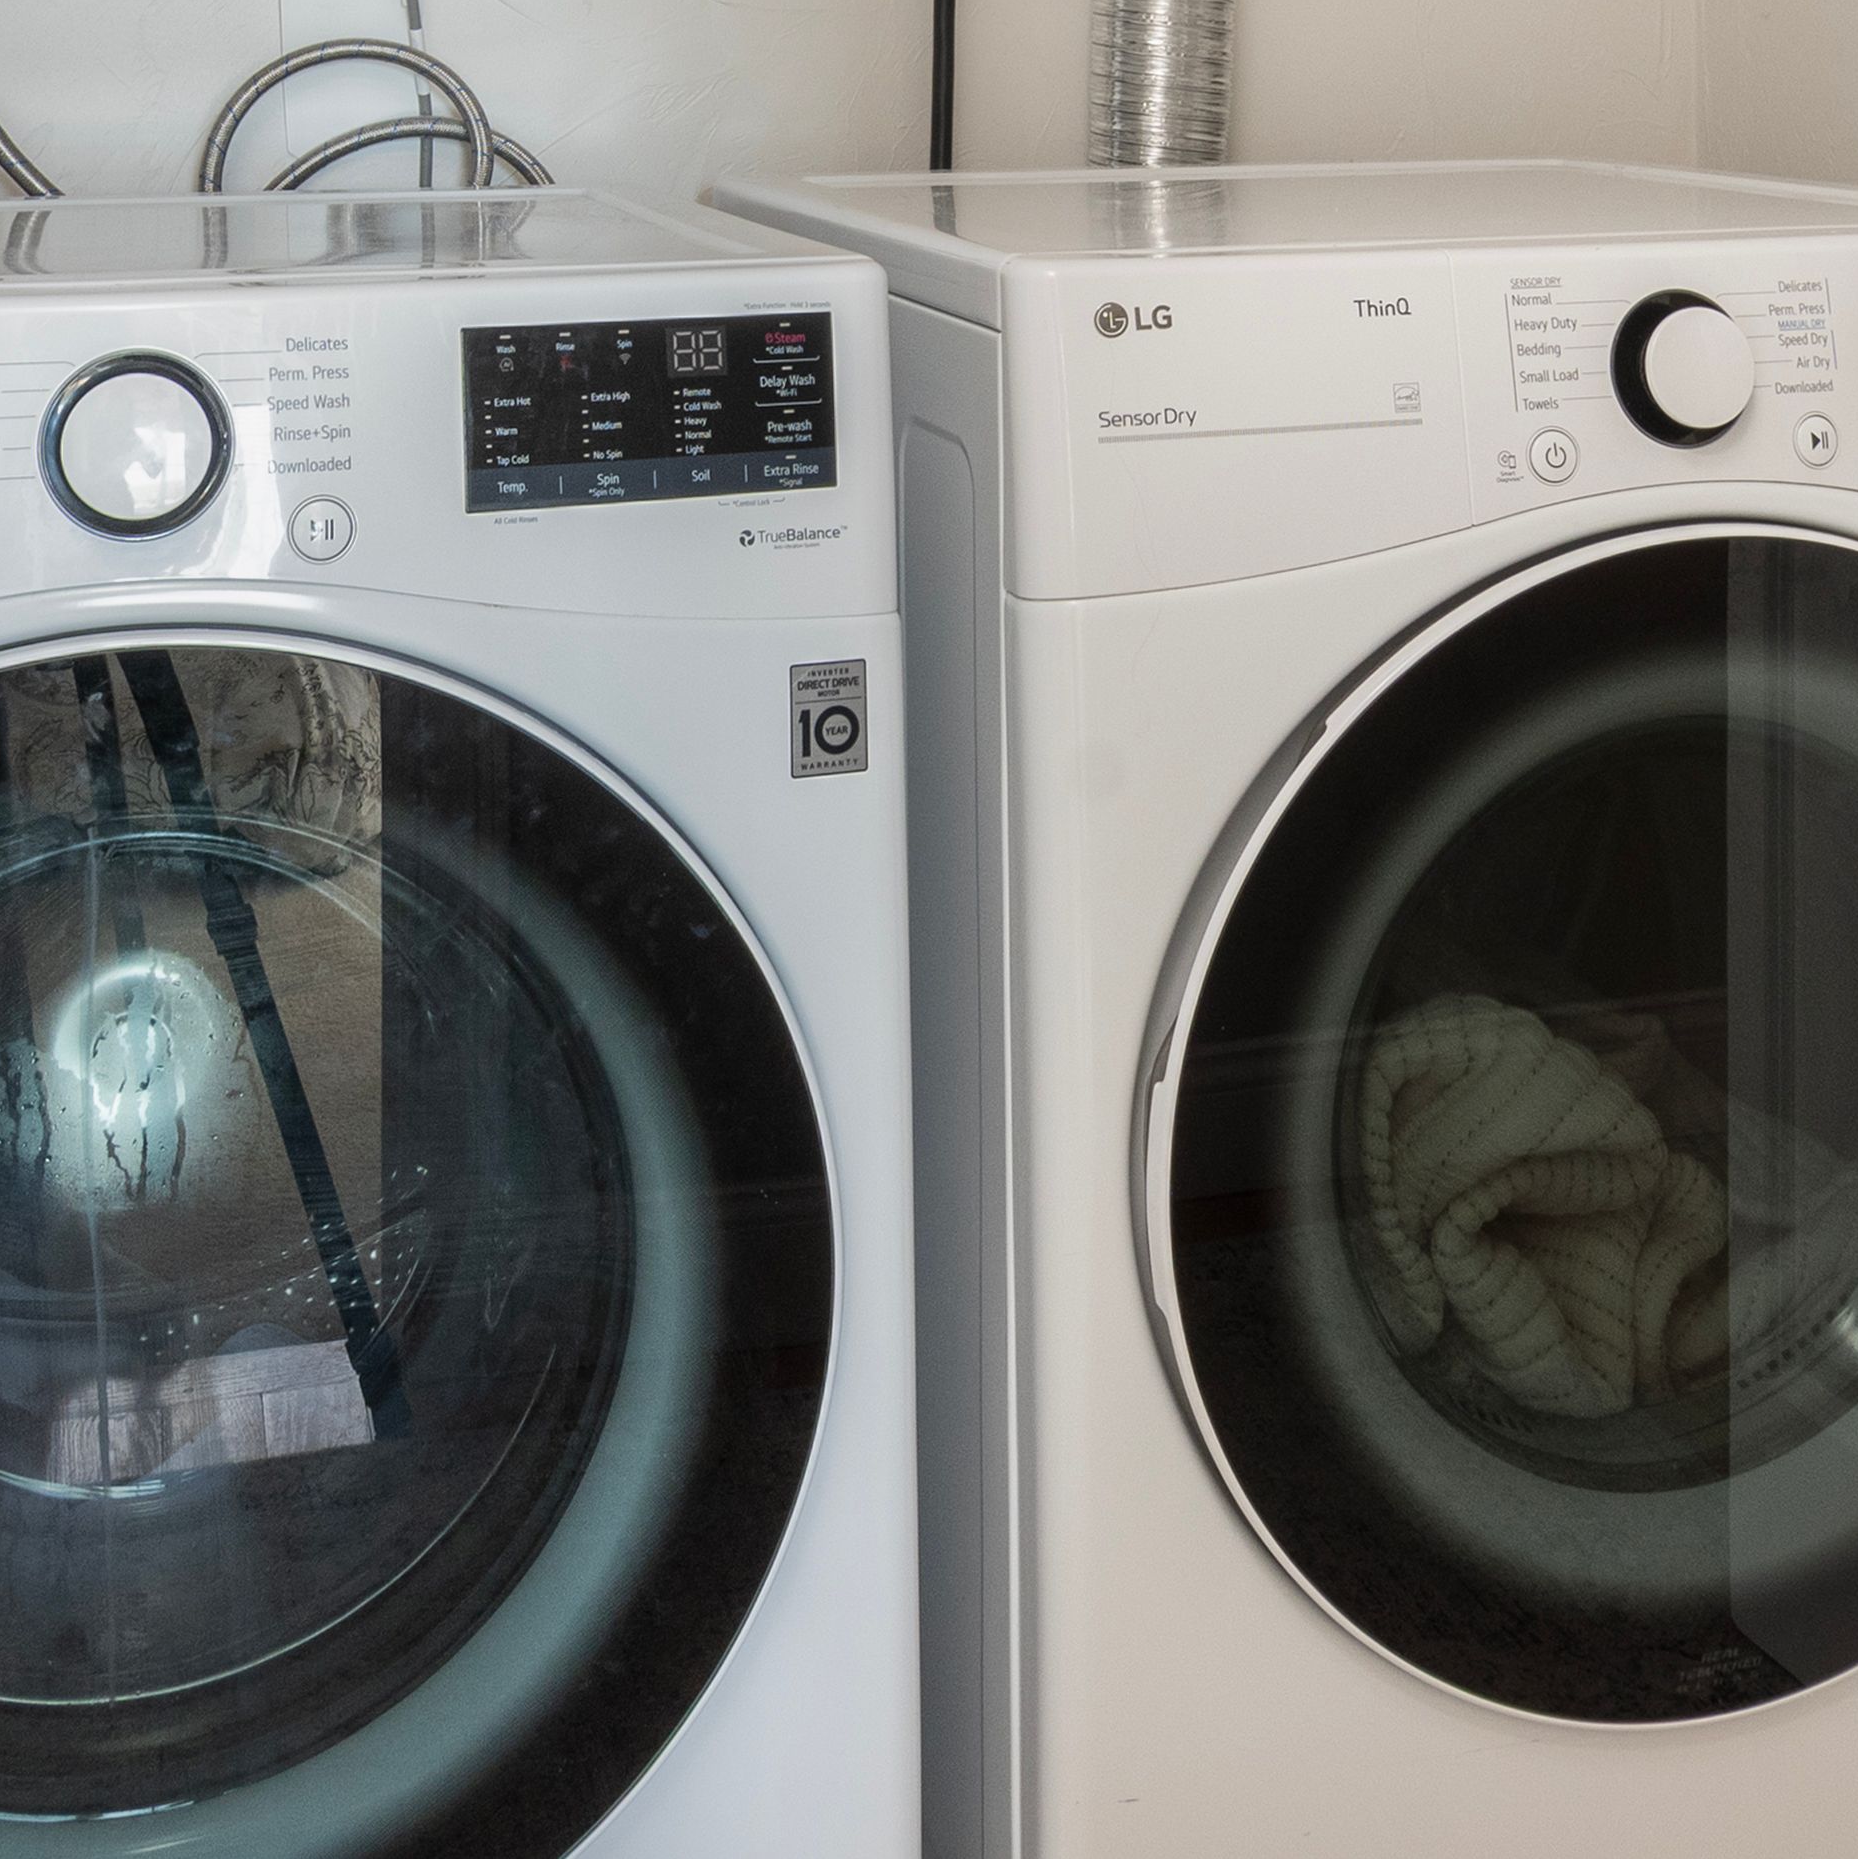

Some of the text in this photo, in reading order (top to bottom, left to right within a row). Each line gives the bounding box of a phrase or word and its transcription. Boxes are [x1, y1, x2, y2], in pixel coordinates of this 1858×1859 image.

[1778, 280, 1823, 292] Delicates
[1511, 293, 1553, 306] Normal
[1353, 297, 1412, 317] ThinQ
[1769, 302, 1825, 316] Perm. Press
[1134, 305, 1173, 331] LG
[1514, 316, 1577, 333] Heavy Duty
[285, 336, 349, 352] Delicates
[617, 340, 633, 349] Spin
[774, 332, 806, 344] Steam
[1778, 332, 1828, 348] Speed Dry
[496, 345, 516, 354] Wash
[555, 342, 575, 352] Rinse
[783, 345, 804, 354] Wash
[1517, 343, 1562, 358] Bedding
[1797, 356, 1831, 370] Air Dry
[269, 365, 350, 382] Perm. Press
[1519, 368, 1579, 384] Small Load
[759, 374, 815, 389] Delay Wash
[1775, 380, 1833, 394] Downloaded
[591, 392, 631, 402] Extra High
[683, 388, 711, 398] Remote
[267, 393, 351, 414] Speed Wash
[493, 396, 531, 407] Extra Hot
[683, 401, 721, 412] Cold Wash
[1522, 397, 1559, 411] Towels
[684, 417, 707, 427] Heavy
[1098, 407, 1197, 428] Sensor Dry
[495, 427, 519, 436] Warm
[592, 422, 623, 431] Medium
[767, 420, 813, 433] Pre-wash
[274, 424, 351, 443] Rinse+Spin
[685, 430, 712, 440] Normal
[593, 450, 623, 460] No Spin
[685, 445, 705, 456] Light
[267, 455, 351, 474] Downloaded
[497, 454, 529, 466] Tap Cold
[691, 470, 711, 482] Soil
[763, 463, 819, 477] Extra Rinse
[597, 473, 619, 486] Spin
[497, 481, 529, 494] Temp.
[609, 486, 625, 497] Only
[807, 668, 849, 677] INVERTER
[797, 676, 860, 691] DIRECT DRIVE
[817, 689, 841, 697] MOTOR
[798, 705, 860, 758] 10
[825, 724, 849, 736] YEAR
[801, 758, 859, 770] WARRANTY
